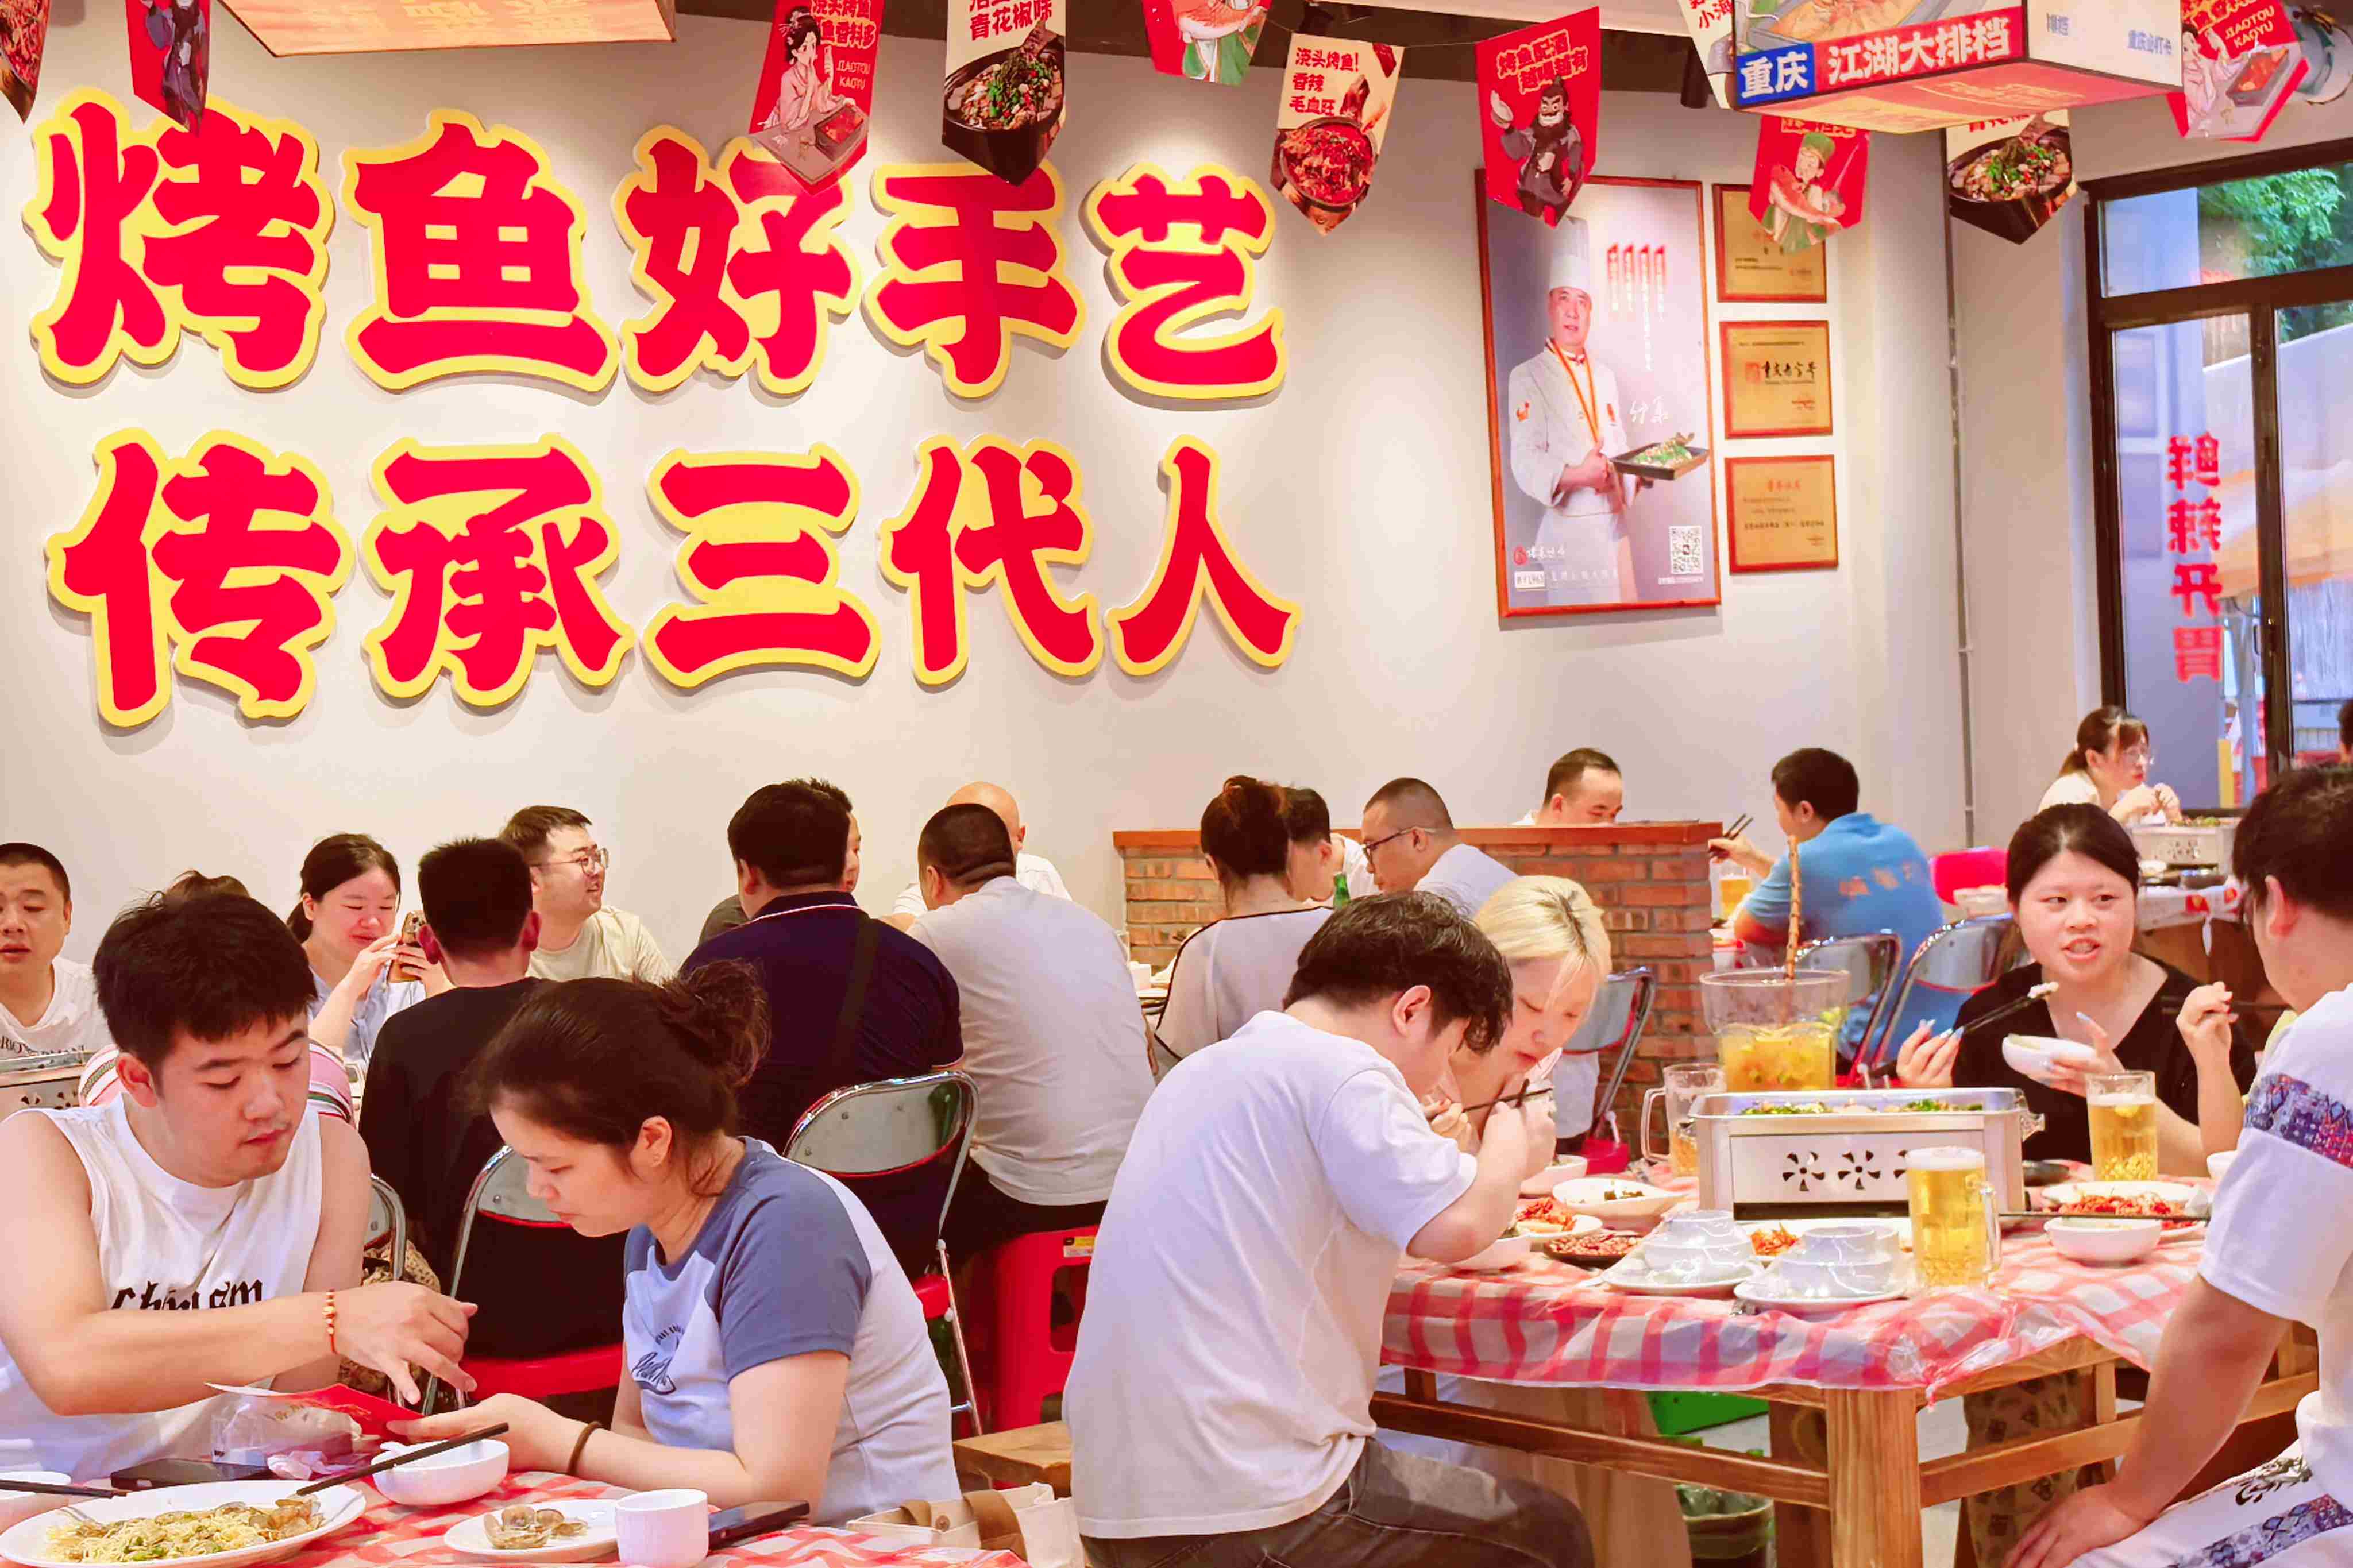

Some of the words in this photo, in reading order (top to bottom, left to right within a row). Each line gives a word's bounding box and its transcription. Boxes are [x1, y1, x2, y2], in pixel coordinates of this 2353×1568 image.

[970, 0, 1052, 41] 青花椒味
[1292, 73, 1325, 92] 香辣
[1741, 51, 1809, 99] 重庆
[1828, 16, 2011, 85] 江湖大排档
[1289, 95, 1336, 117] 毛血旺
[26, 87, 1284, 399] 烤鱼好手艺
[47, 428, 1298, 728] 传承三代人
